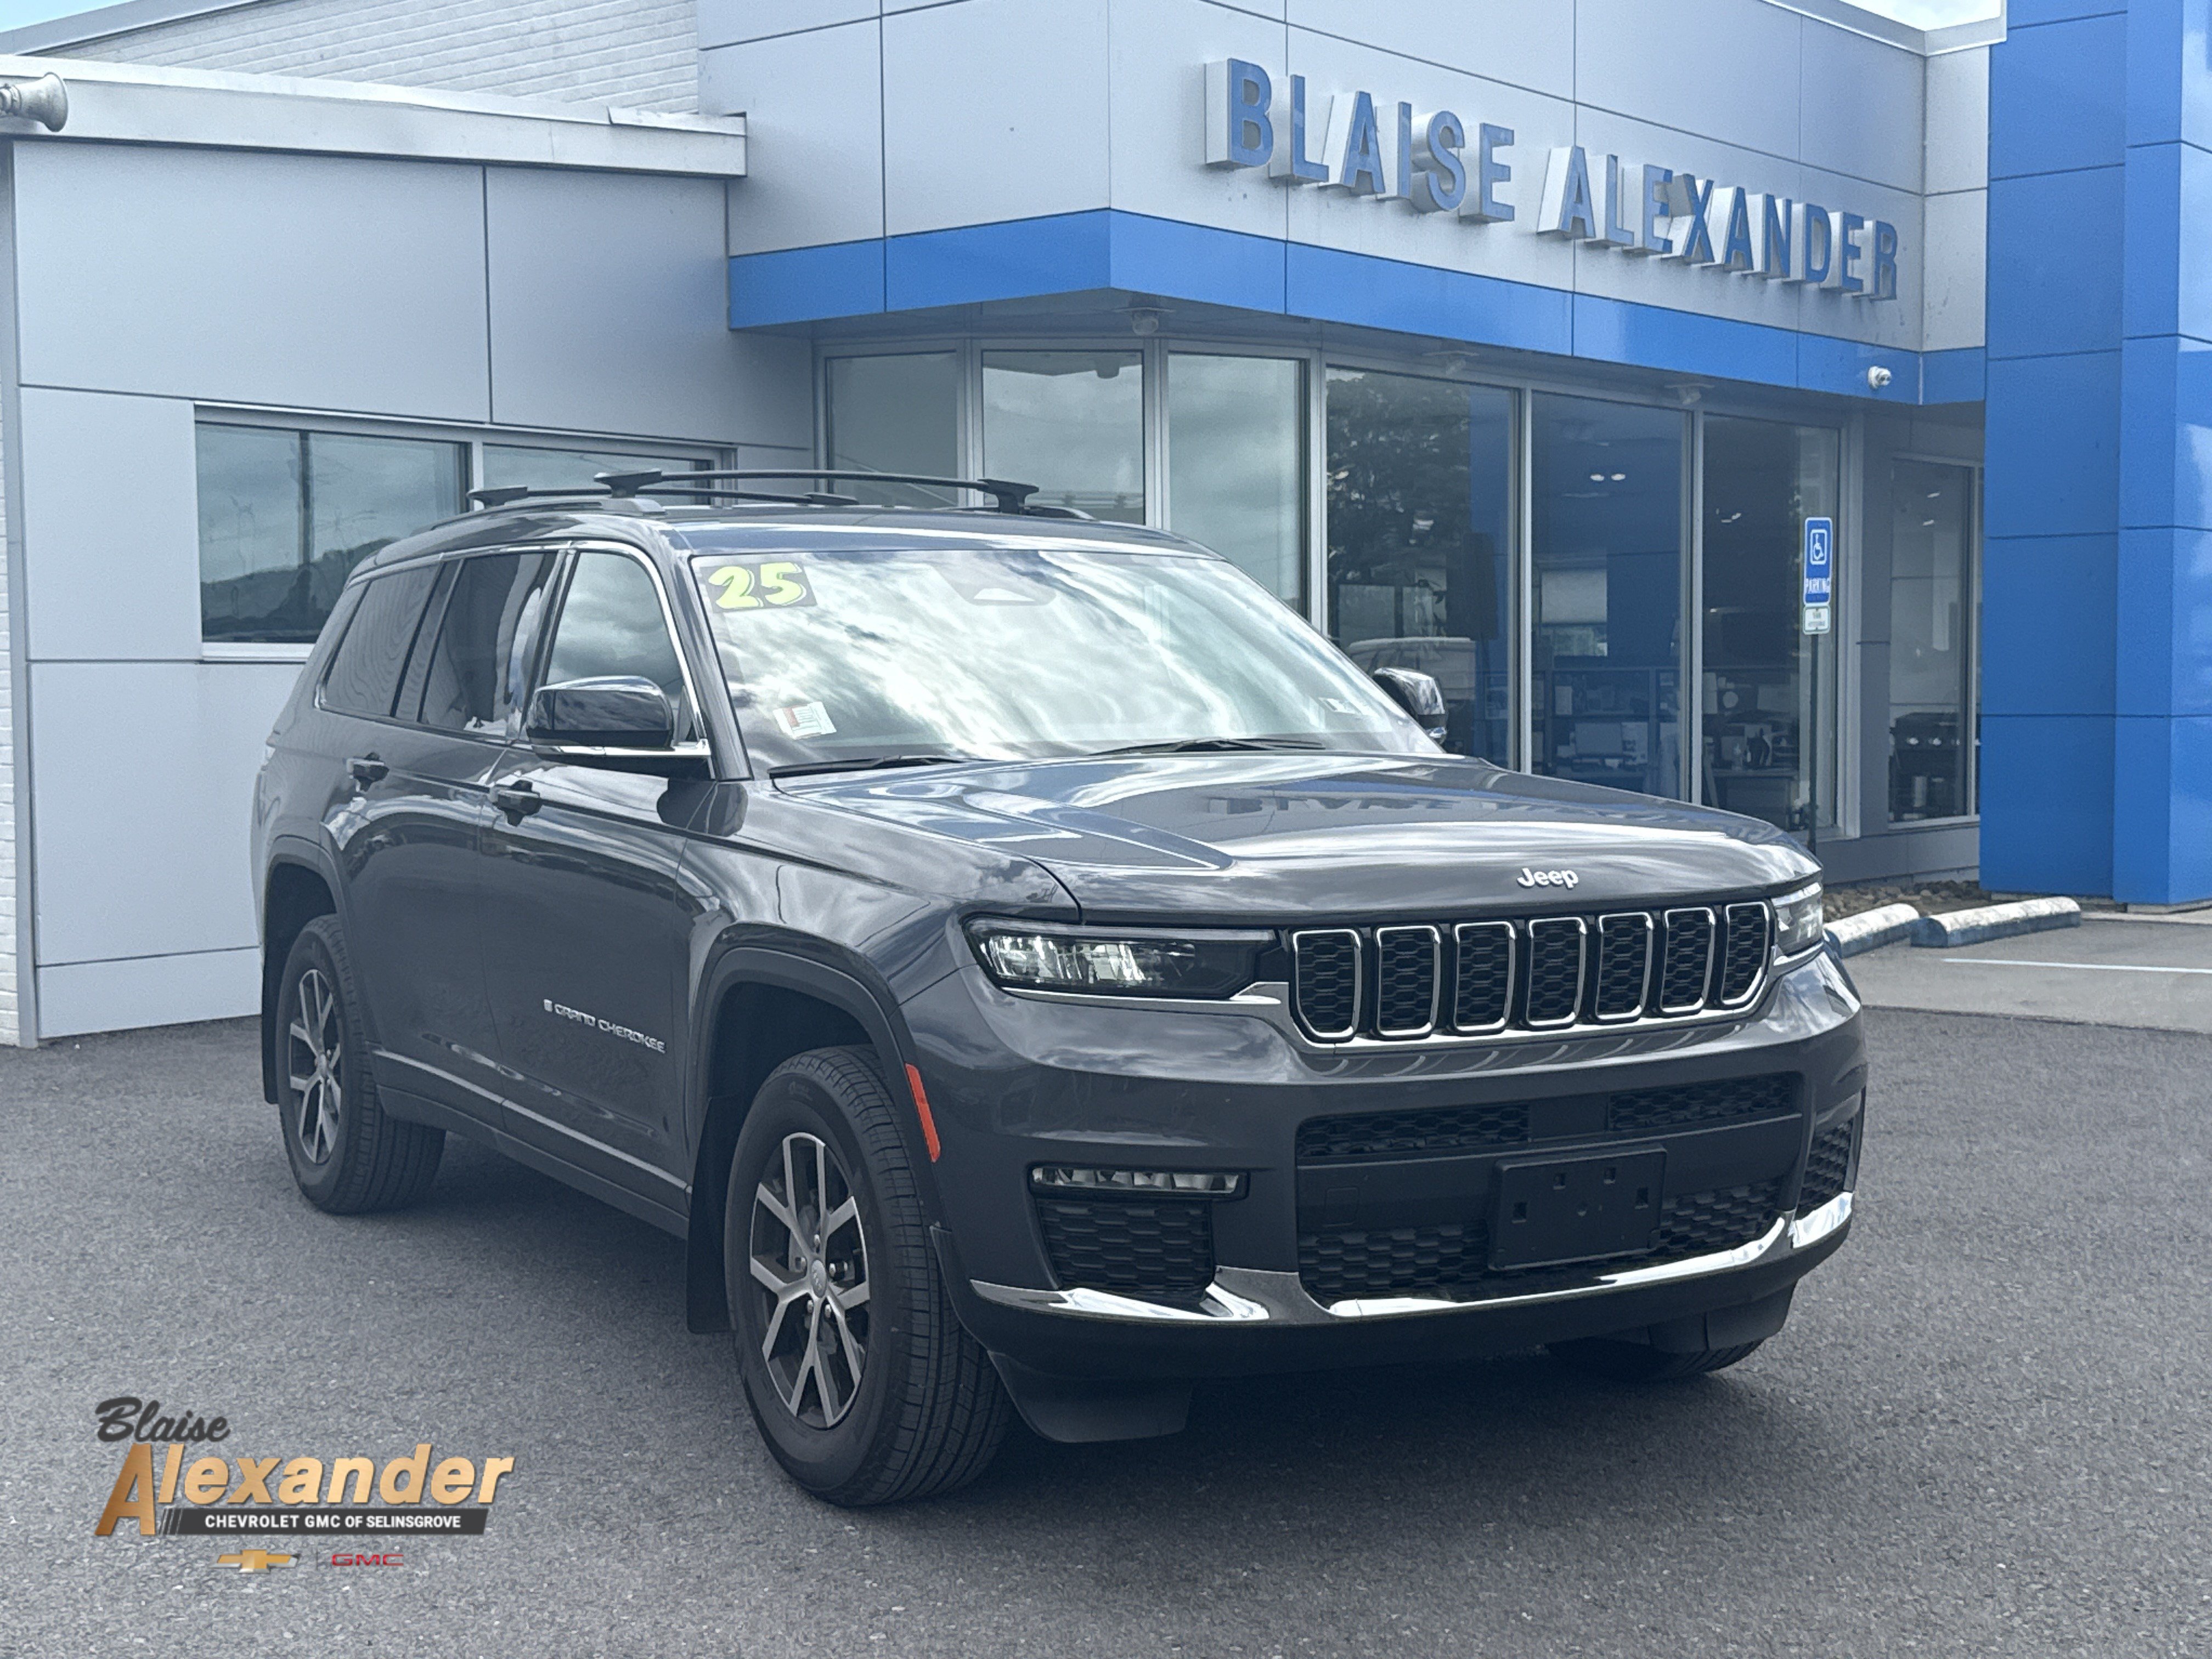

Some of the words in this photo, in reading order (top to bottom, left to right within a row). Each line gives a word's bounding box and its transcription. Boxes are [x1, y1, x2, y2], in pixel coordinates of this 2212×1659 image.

[1224, 57, 1515, 223] BLAISE
[1560, 145, 1898, 301] ALEXANDER
[708, 562, 806, 610] 25
[1516, 867, 1579, 889] Jeep
[554, 1004, 596, 1027] GRAND
[598, 1019, 665, 1054] CHEROKEE
